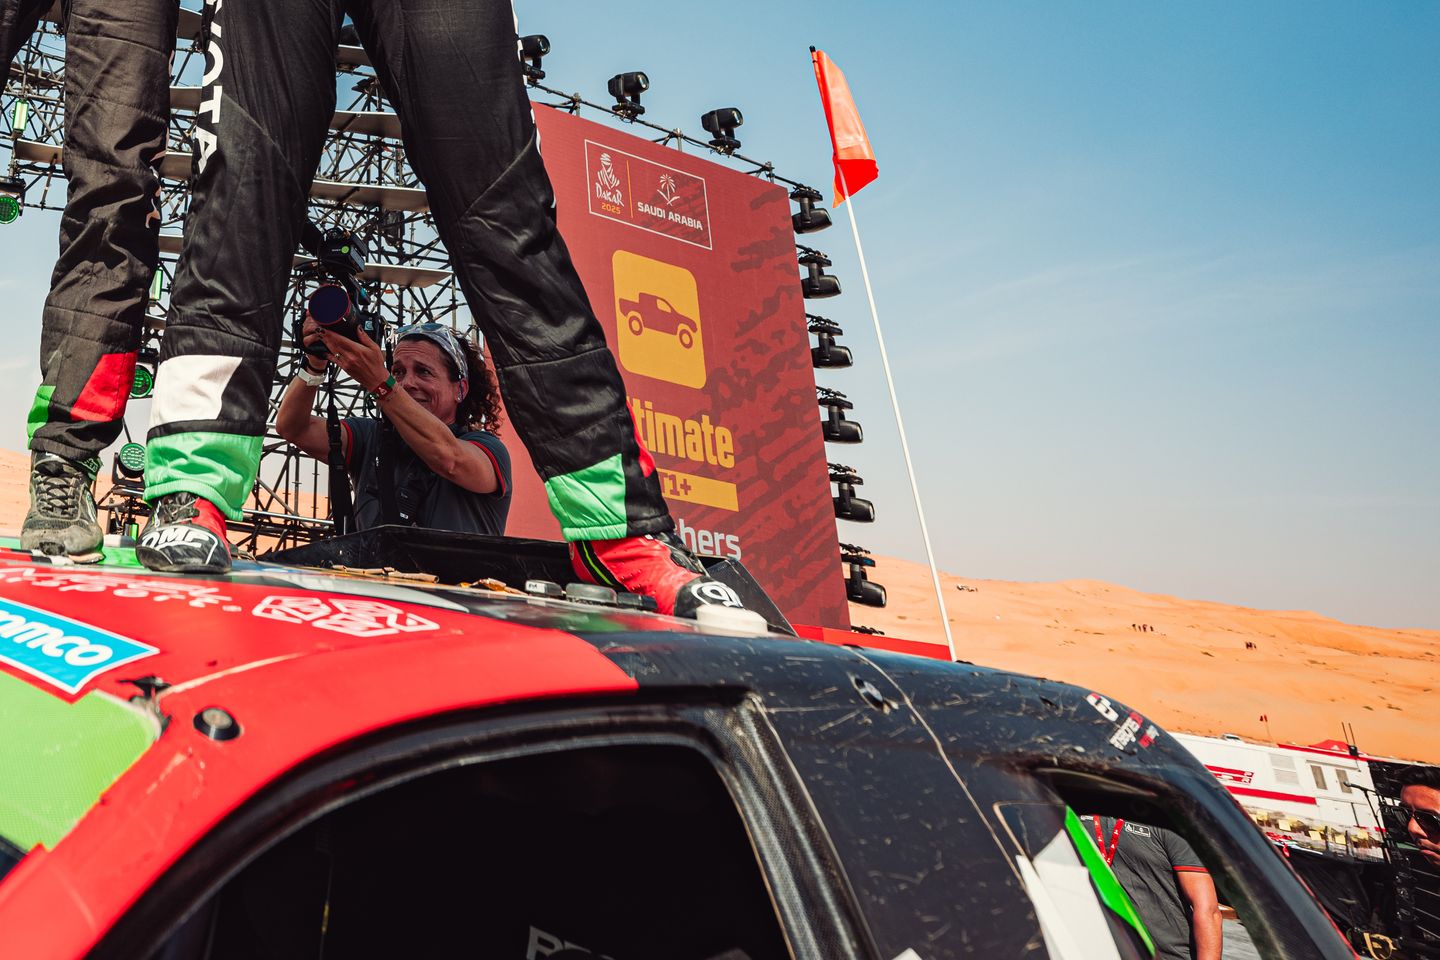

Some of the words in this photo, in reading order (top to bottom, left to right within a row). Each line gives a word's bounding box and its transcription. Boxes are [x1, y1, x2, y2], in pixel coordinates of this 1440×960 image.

[595, 182, 625, 207] DAKAR
[601, 202, 621, 215] 2025
[637, 201, 666, 219] SAUDI
[668, 211, 703, 231] ARABIA
[627, 396, 735, 469] timate
[674, 518, 742, 561] hers
